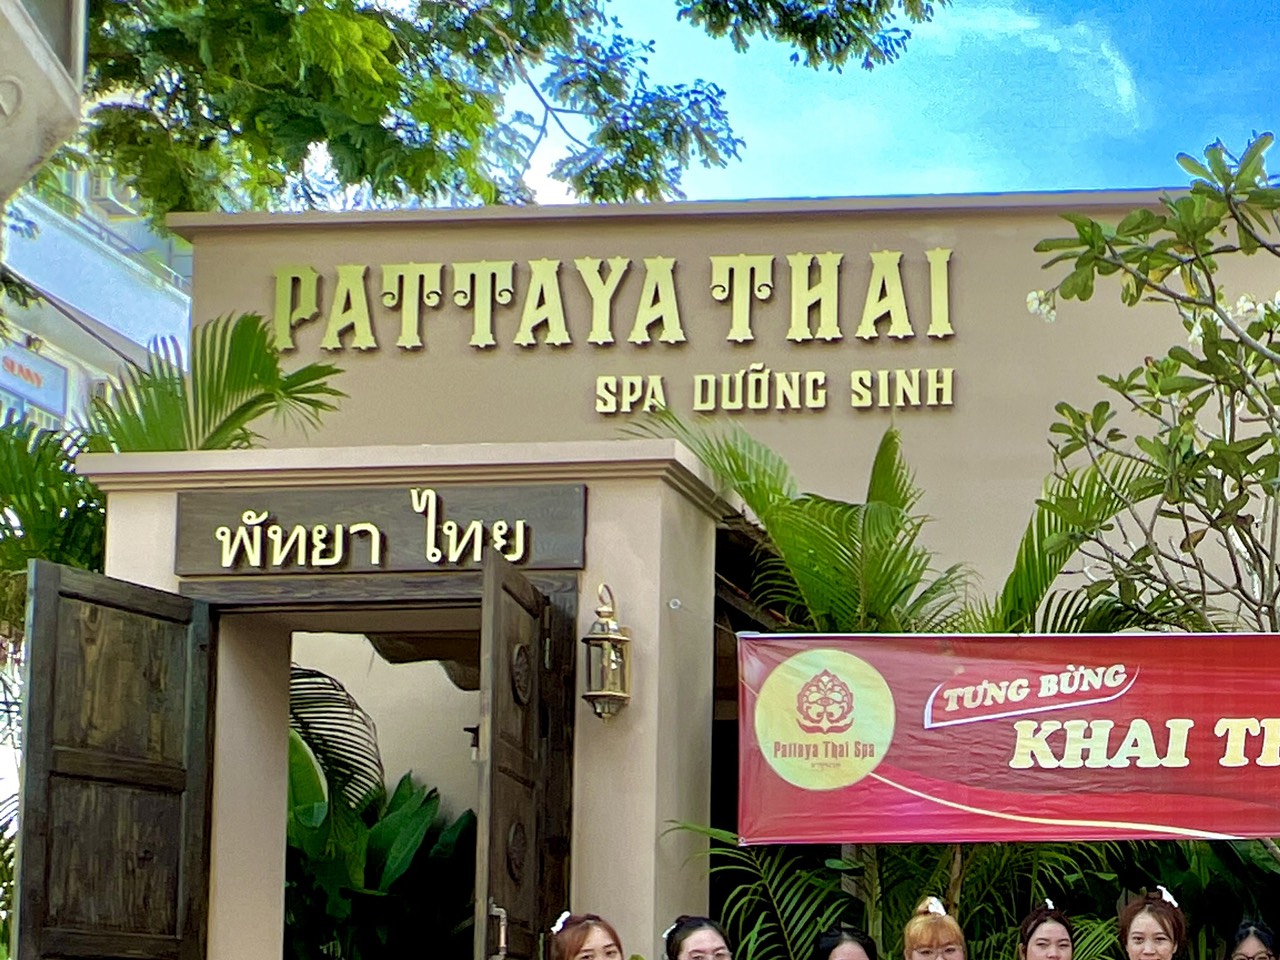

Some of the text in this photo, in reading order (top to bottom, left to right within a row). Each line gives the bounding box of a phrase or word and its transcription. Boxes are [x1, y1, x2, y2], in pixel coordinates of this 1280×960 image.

[272, 247, 955, 352] PATTAYA THAI
[595, 362, 955, 413] SPA DƯỠNG SINH
[214, 488, 526, 568] พัทยา ไทย
[943, 663, 1128, 712] TƯNG BỪNG
[773, 740, 875, 761] Pattaya Thai Spa
[1009, 717, 1195, 769] KHAI
